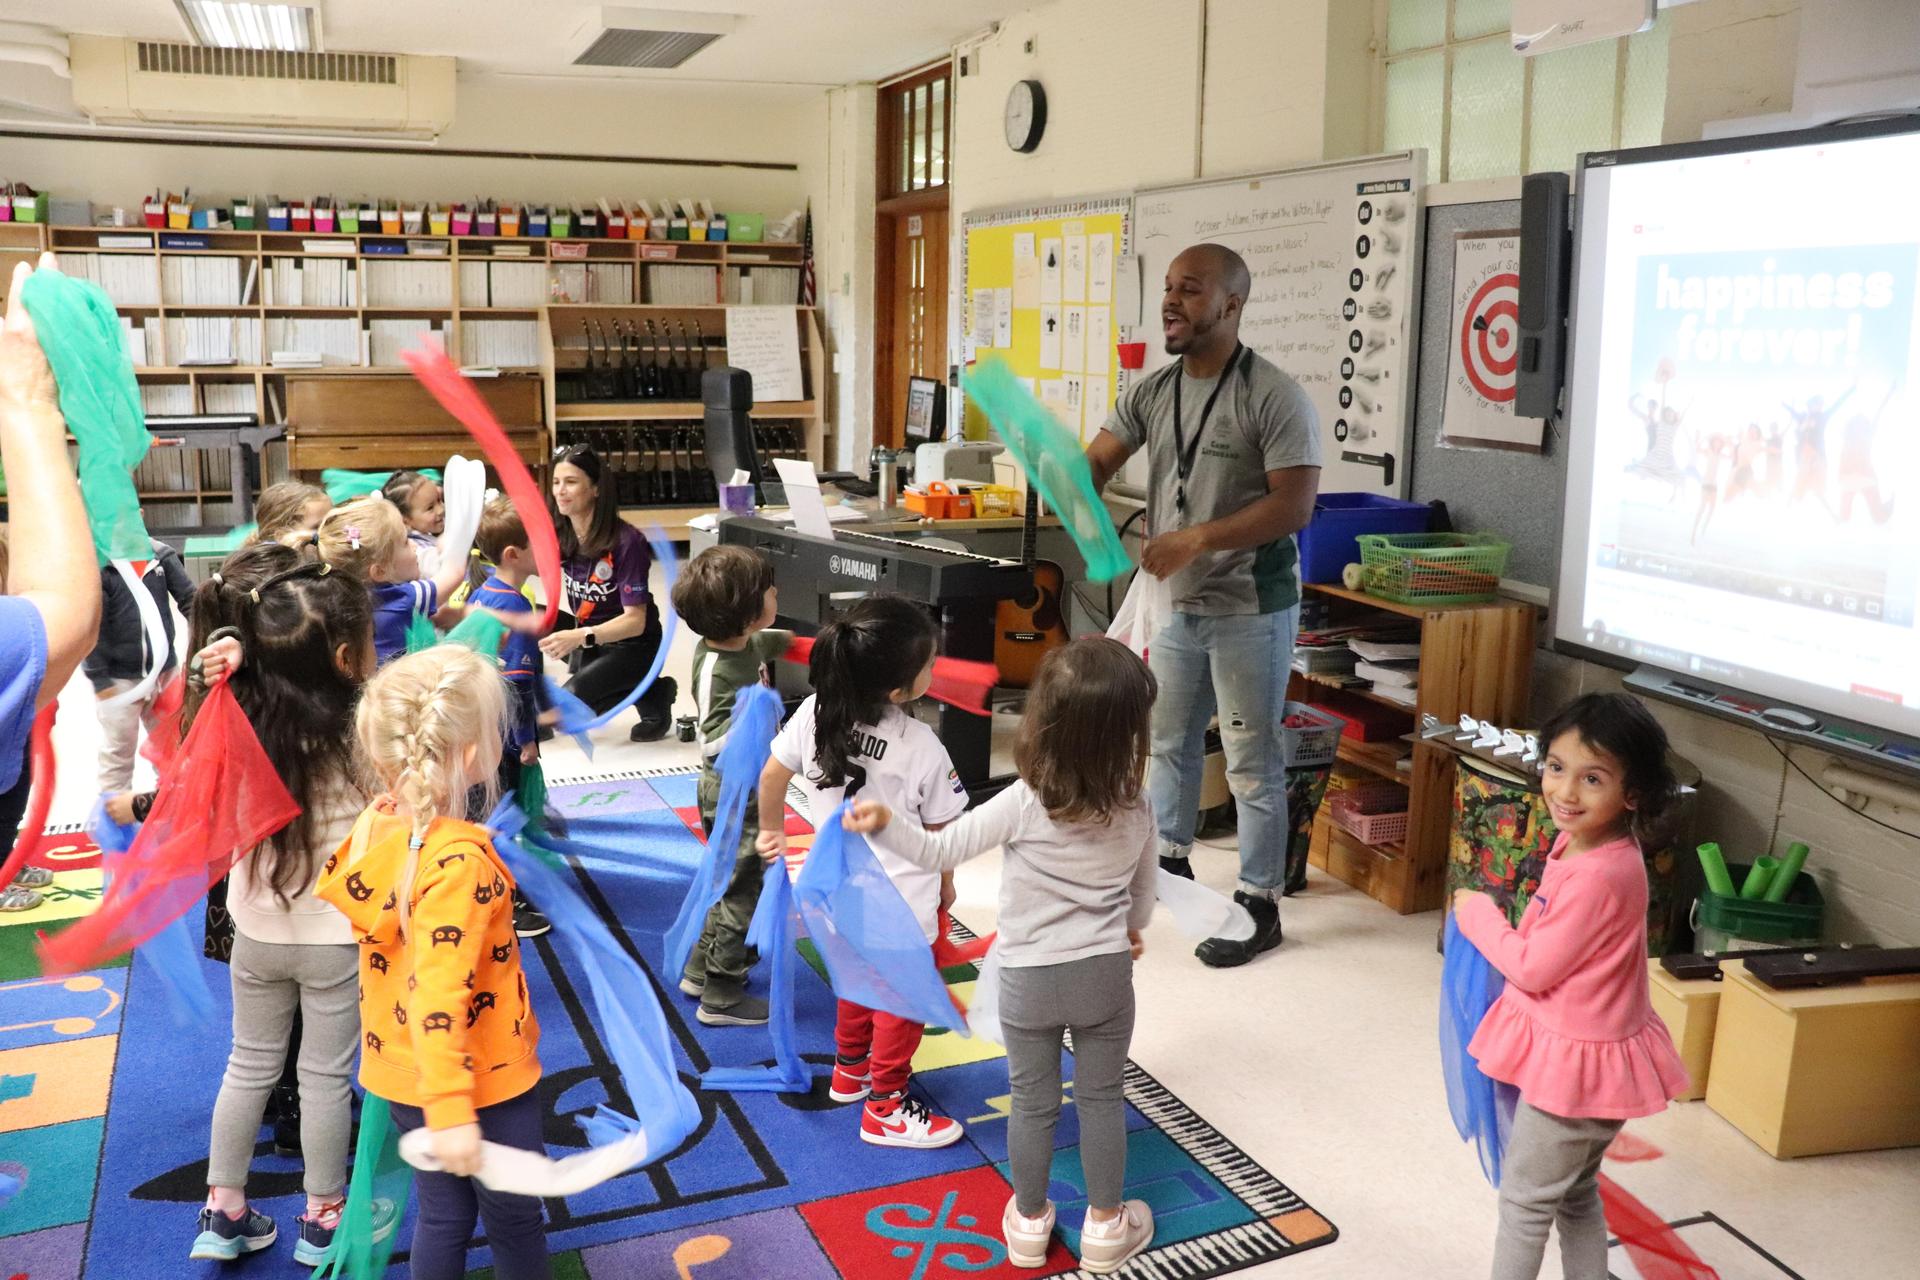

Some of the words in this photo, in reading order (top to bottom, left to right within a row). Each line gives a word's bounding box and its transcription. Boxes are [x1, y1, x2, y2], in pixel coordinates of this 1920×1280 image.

[1462, 240, 1487, 252] When
[1497, 239, 1515, 251] you
[1480, 260, 1503, 281] your
[1655, 256, 1895, 325] happiness
[1677, 311, 1863, 367] forever!
[841, 557, 877, 582] YAMAHA
